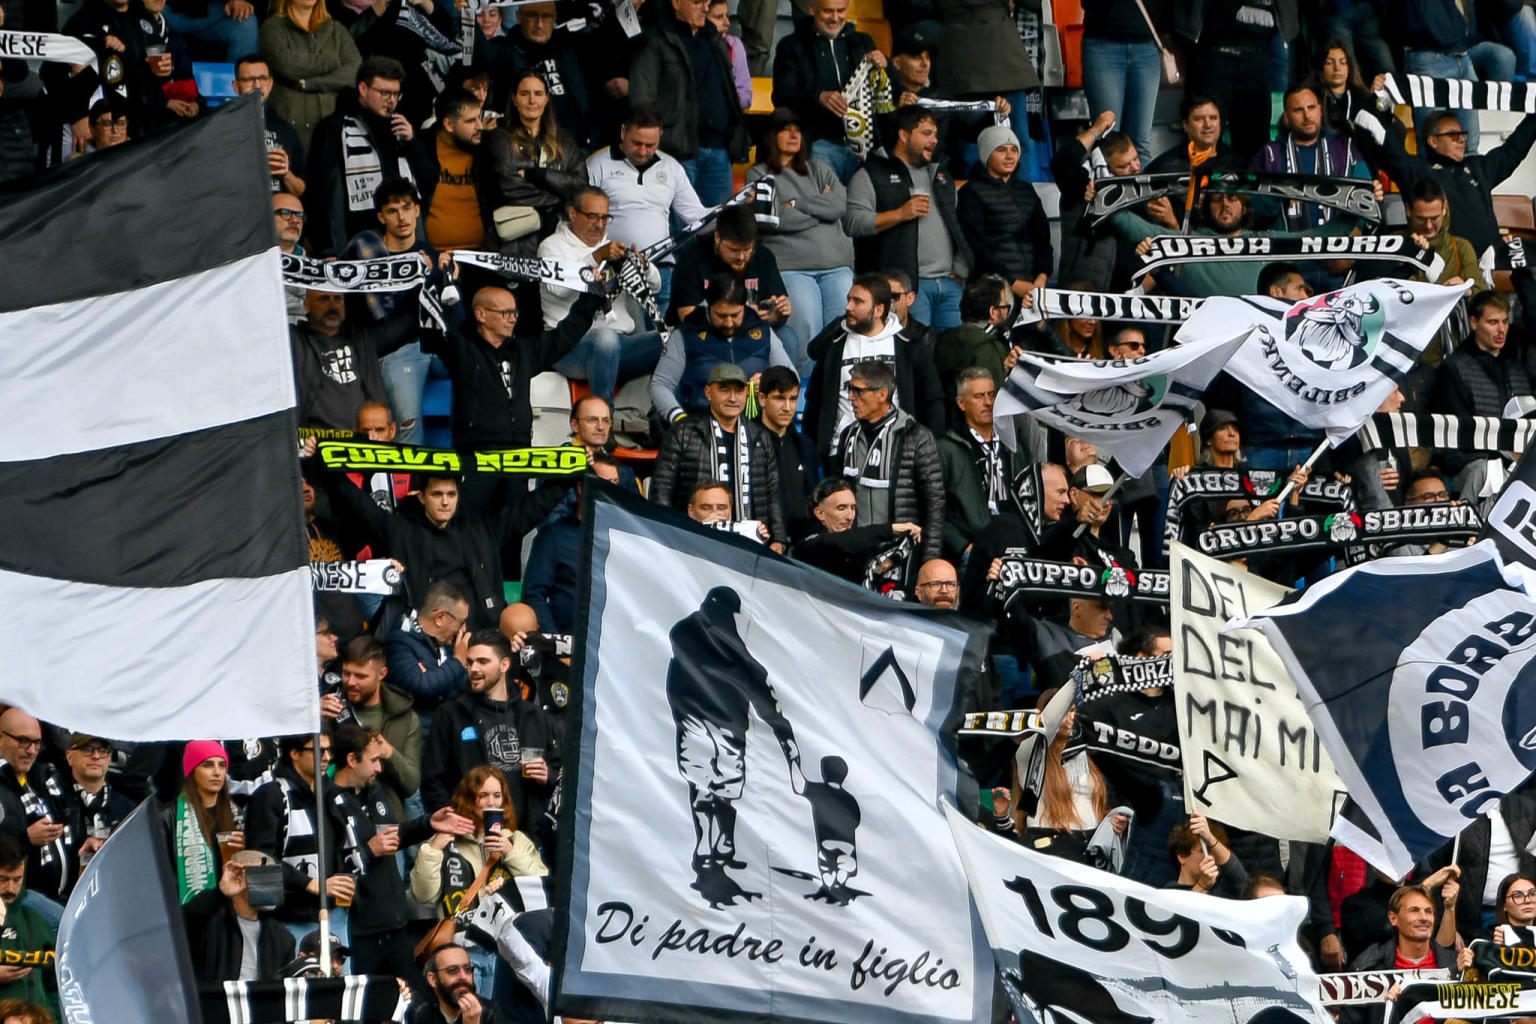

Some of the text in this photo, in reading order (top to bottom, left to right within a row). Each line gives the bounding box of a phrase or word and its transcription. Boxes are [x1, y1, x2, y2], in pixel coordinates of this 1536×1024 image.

[1301, 235, 1402, 254] NORD
[320, 445, 588, 472] CURVA NORD
[1200, 516, 1317, 552] GRUPPO
[1001, 557, 1097, 588] GRUPPO
[1181, 623, 1276, 690] DEL
[1093, 720, 1181, 761] TEDD
[1003, 874, 1247, 959] 189
[594, 901, 962, 997] Di padre in figlio
[1437, 983, 1521, 1009] UDINESE
